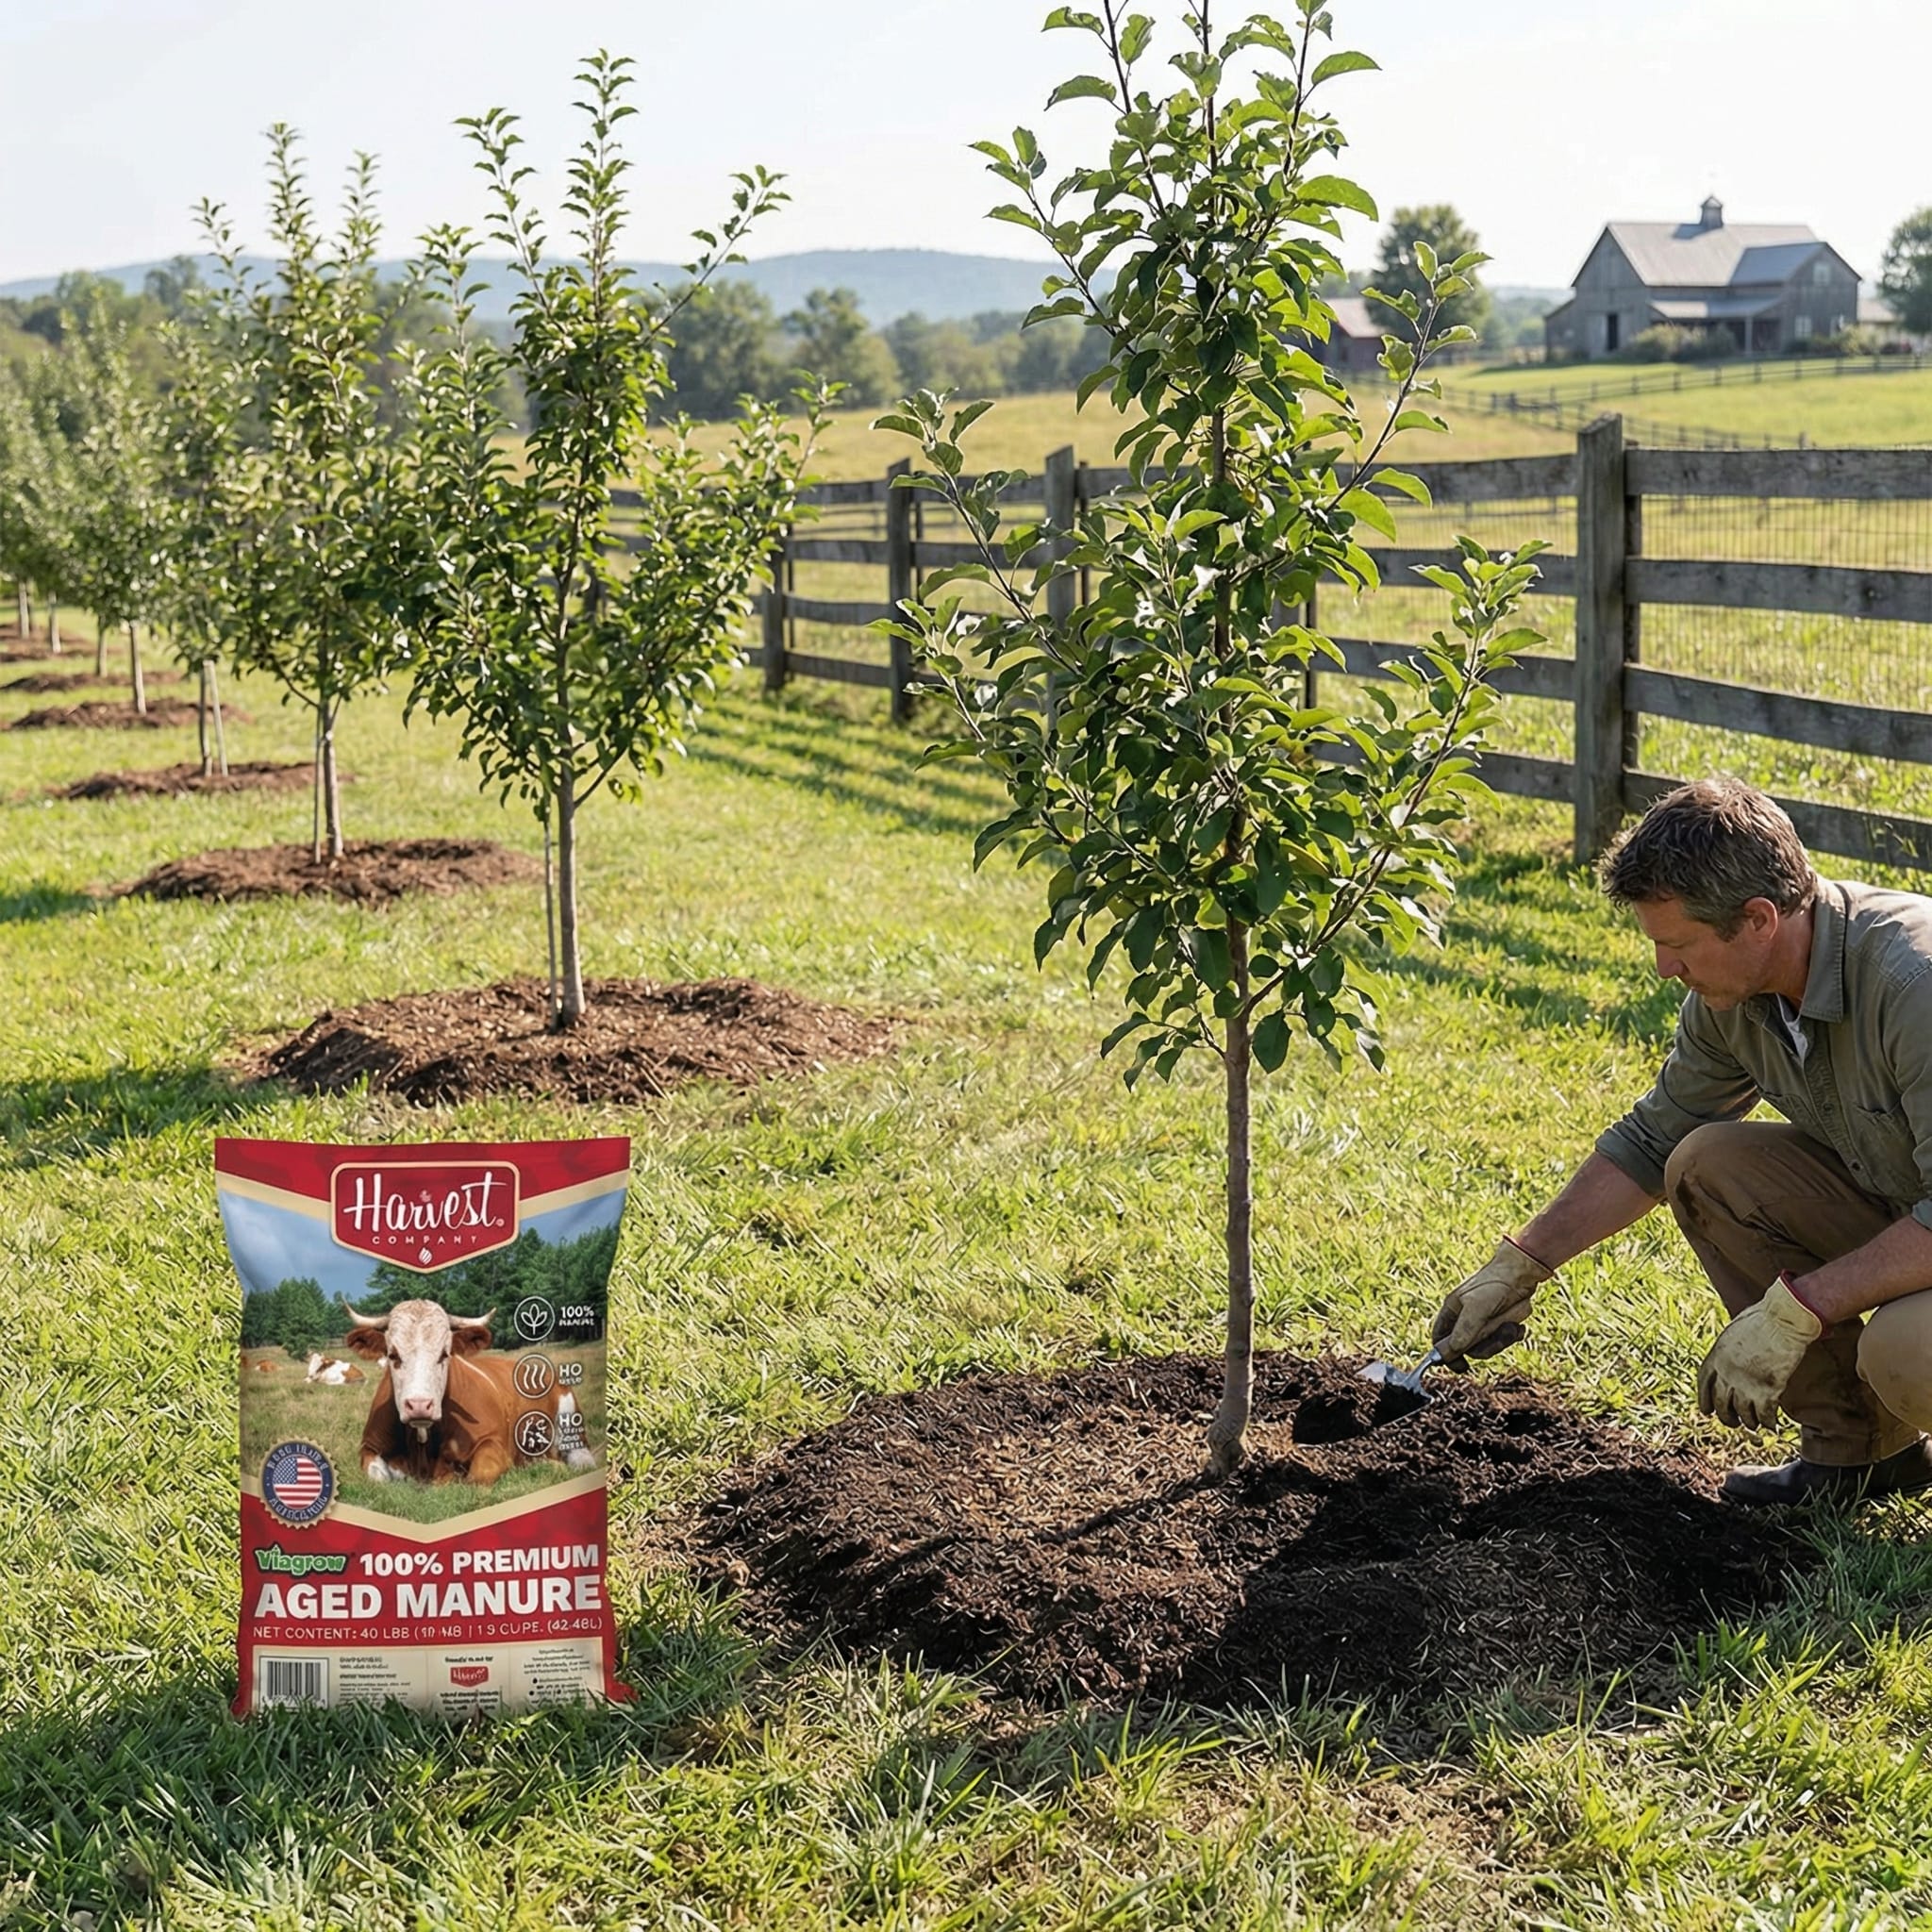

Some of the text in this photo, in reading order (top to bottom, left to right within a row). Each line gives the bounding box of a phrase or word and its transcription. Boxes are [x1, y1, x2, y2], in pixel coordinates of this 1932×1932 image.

[343, 1172, 508, 1232] Harvest
[372, 1235, 477, 1244] COMPANY
[560, 1306, 594, 1318] 100%
[255, 1544, 599, 1576] Viagrow 100% PREMIUM
[254, 1574, 602, 1619] AGED MANURE
[253, 1626, 281, 1639] NET
[285, 1627, 358, 1640] CONTENT:
[360, 1627, 378, 1639] 40
